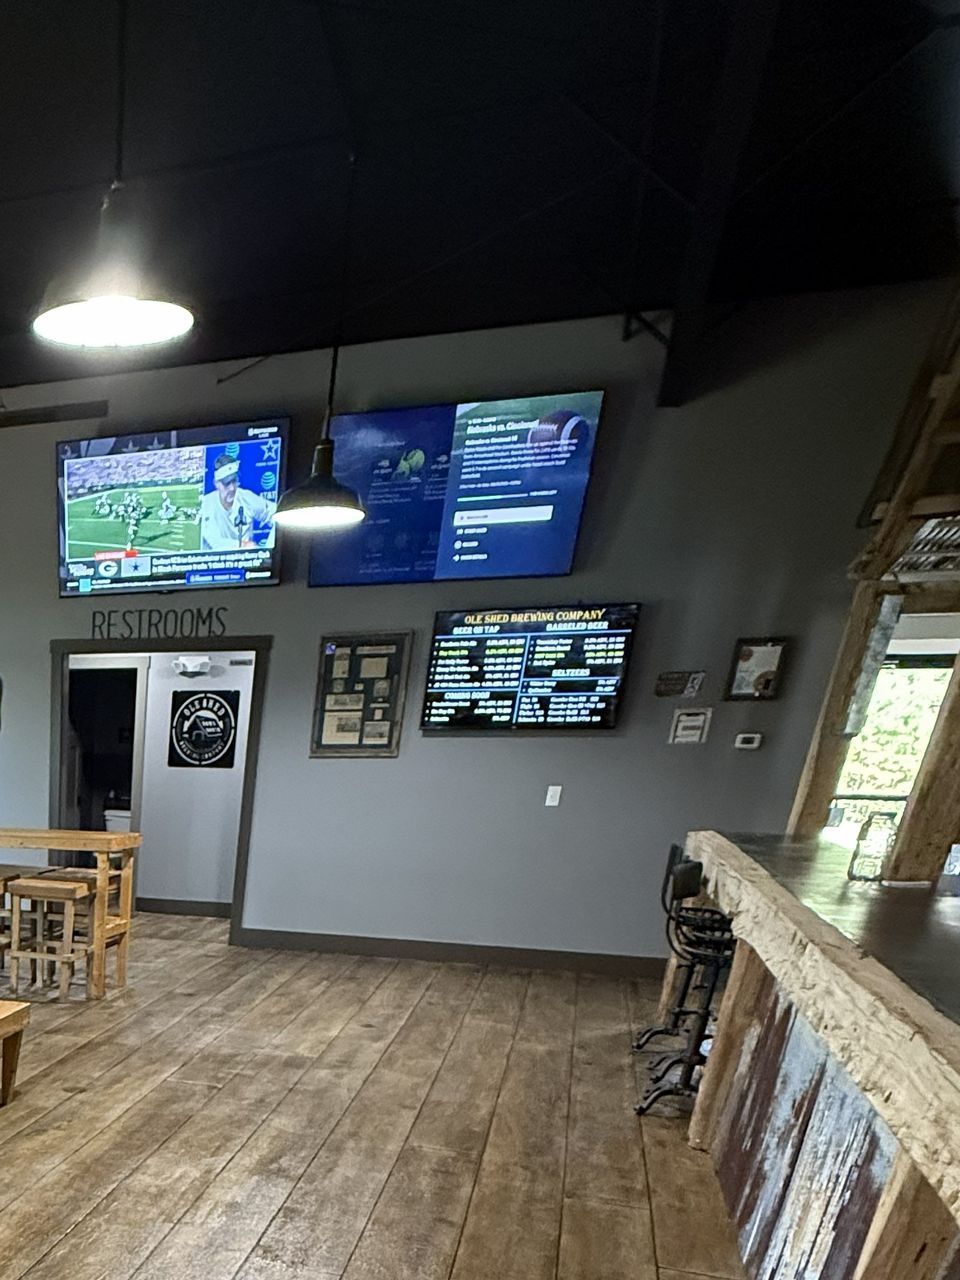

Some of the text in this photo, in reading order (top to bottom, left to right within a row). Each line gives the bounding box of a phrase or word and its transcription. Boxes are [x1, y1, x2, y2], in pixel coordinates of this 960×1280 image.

[91, 607, 229, 640] RESTROOMS
[464, 608, 607, 625] OLE SHED BREWING COMPANY
[484, 625, 500, 634] TAP
[183, 700, 200, 716] OLE
